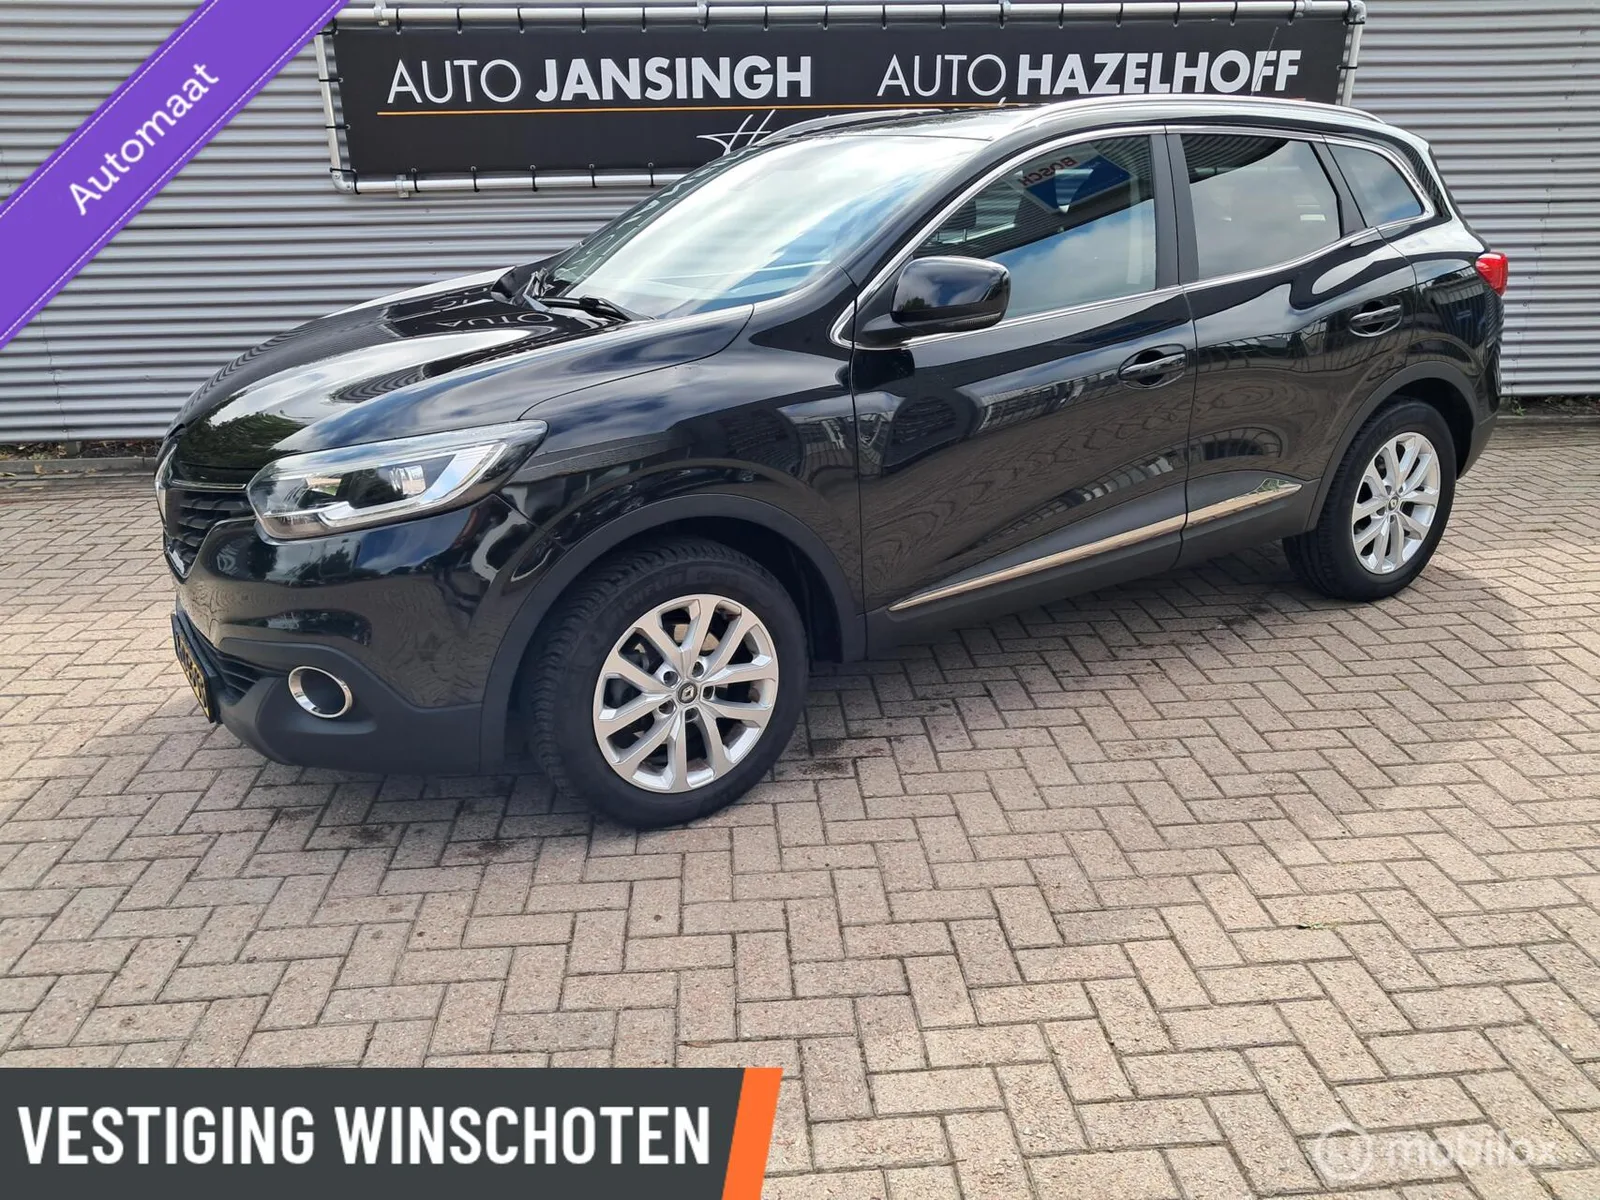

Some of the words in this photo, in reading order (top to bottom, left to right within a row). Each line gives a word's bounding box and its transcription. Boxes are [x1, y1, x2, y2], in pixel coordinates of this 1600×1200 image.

[387, 59, 521, 104] AUTO
[535, 55, 812, 102] JANSINGH
[877, 54, 1007, 97] AUTO
[1016, 49, 1303, 96] HAZELHOFF
